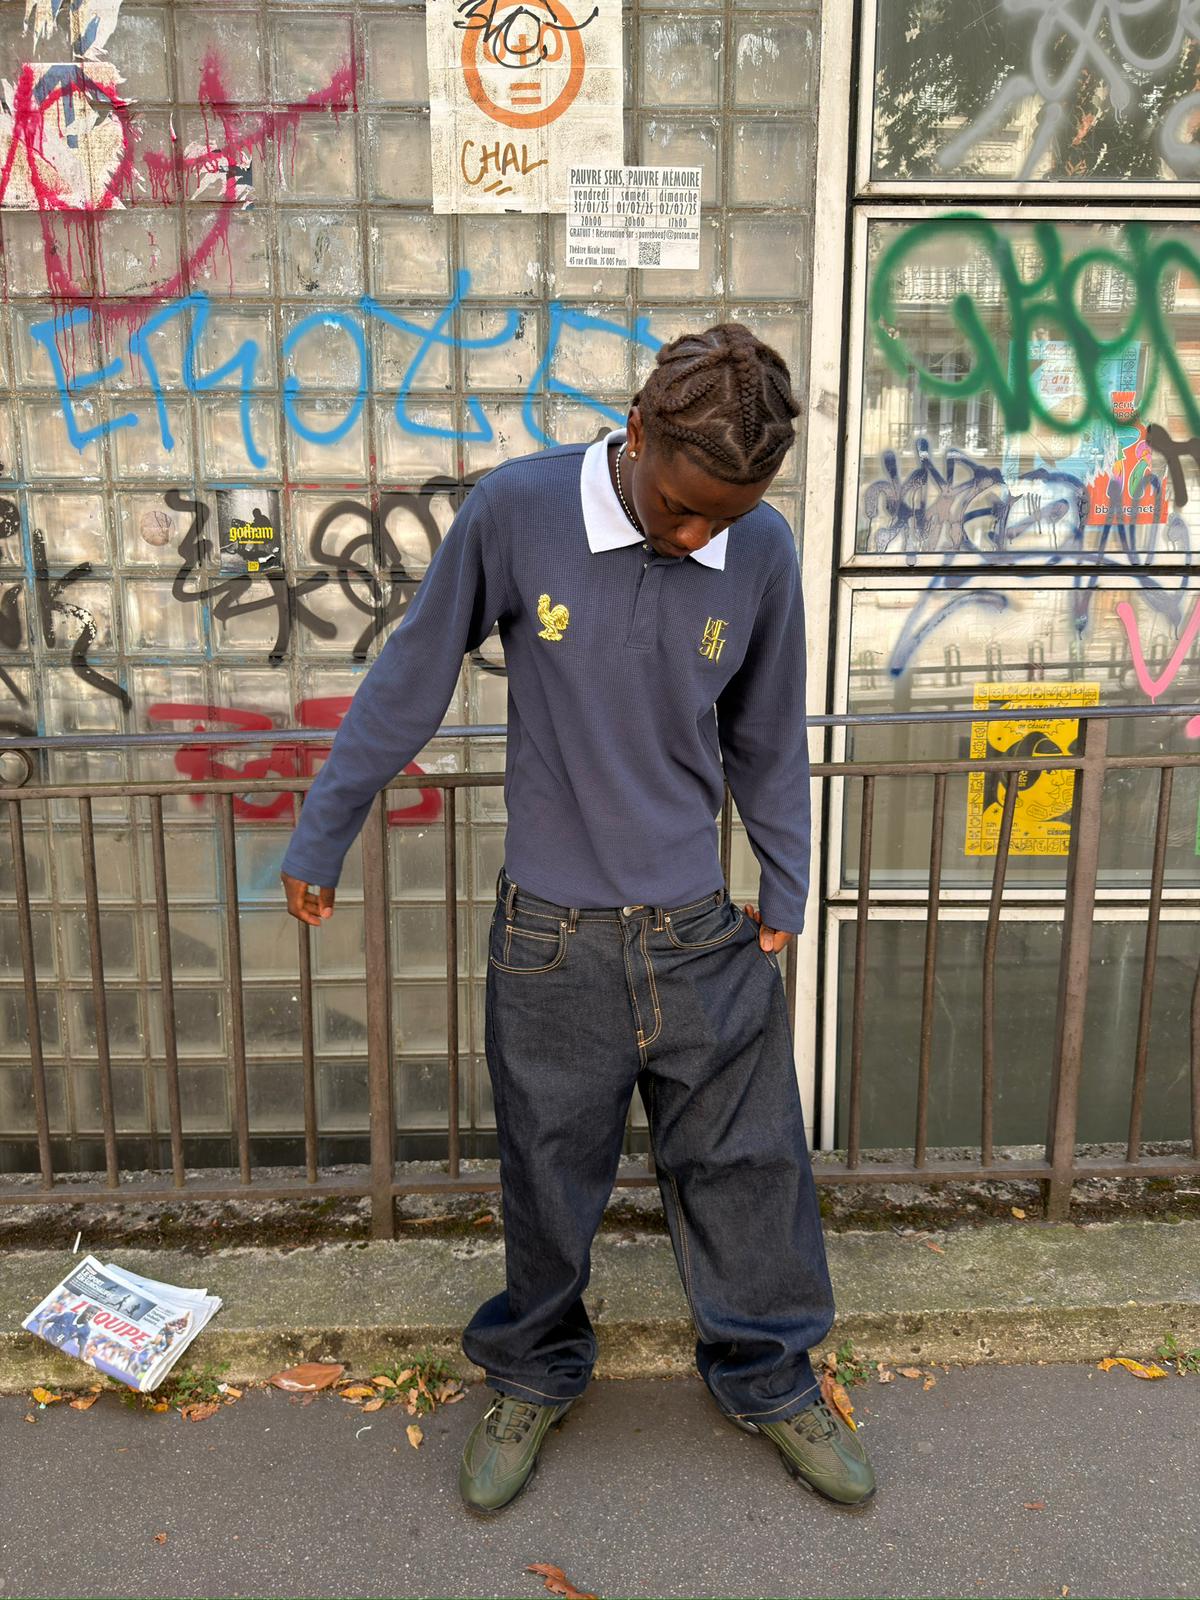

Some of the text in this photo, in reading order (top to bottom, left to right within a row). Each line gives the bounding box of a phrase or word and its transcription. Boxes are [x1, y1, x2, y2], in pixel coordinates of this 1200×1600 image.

[461, 139, 549, 186] CHAL
[570, 168, 700, 187] PAUVRE SENS, PAUVRE MÉMOIRE
[574, 189, 609, 201] vendredi
[621, 189, 649, 202] samedi
[659, 189, 697, 203] dimanche
[574, 201, 609, 213] 31/01/25
[616, 201, 654, 215] 01/02/25
[659, 202, 697, 215] 02/02/25
[581, 215, 602, 227] 20h00
[624, 216, 645, 227] 20h00
[668, 217, 687, 228] 17h00
[569, 228, 592, 237] GRATUIT
[595, 229, 625, 239] Réservation
[569, 245, 587, 254] Théâtre
[587, 245, 601, 254] Nicole
[615, 258, 627, 266] Paris
[229, 522, 273, 542] gotham
